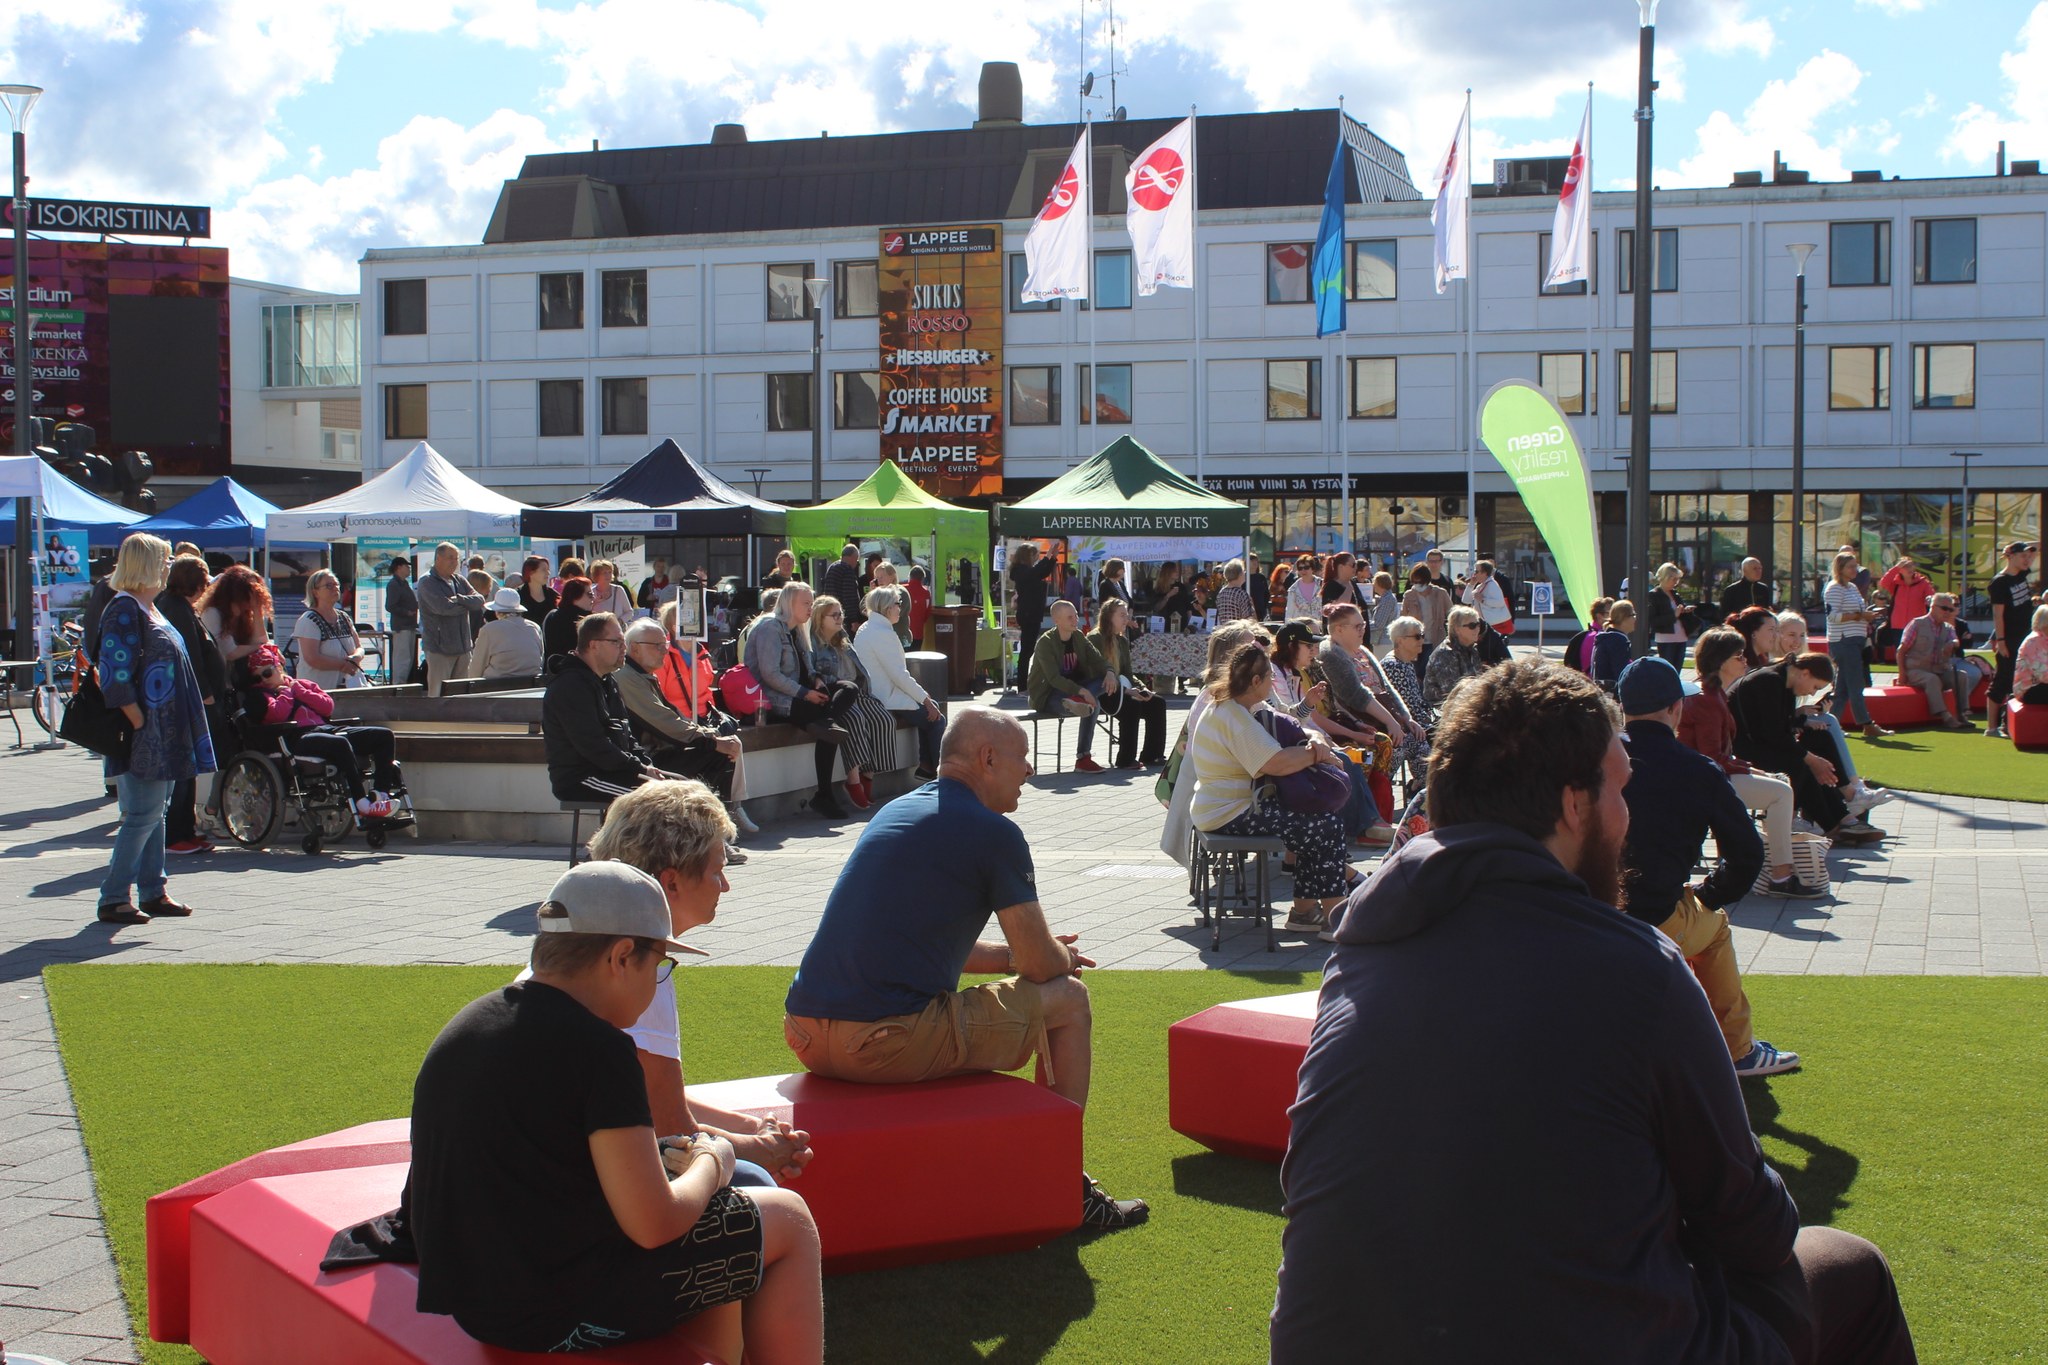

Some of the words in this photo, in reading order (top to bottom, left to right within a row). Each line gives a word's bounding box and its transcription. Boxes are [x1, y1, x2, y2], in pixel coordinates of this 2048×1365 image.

[37, 203, 191, 232] ISOKRISTIINA
[909, 231, 968, 245] LAPPEE
[0, 286, 71, 302] stdium
[913, 284, 961, 309] SOKOS
[908, 314, 969, 333] ROSSO
[9, 326, 82, 339] Sermarket
[897, 349, 980, 365] HESBURGER
[1, 365, 80, 379] Teeystalo
[888, 388, 936, 405] COFFEE
[941, 387, 987, 404] HOUSE
[897, 446, 977, 462] LAPPEE
[947, 465, 978, 473] EVENTS
[1227, 480, 1254, 490] KUIN
[1260, 479, 1287, 490] VIINI
[1292, 479, 1307, 490] JA
[306, 519, 339, 529] Suomen
[1042, 516, 1152, 529] LAPPEENRANTA
[1155, 516, 1209, 529] EVENTS
[589, 536, 638, 558] Martat
[1110, 540, 1192, 550] LAPPEENRANNAN
[1195, 541, 1235, 551] SEUDUN
[662, 1252, 758, 1290] 720
